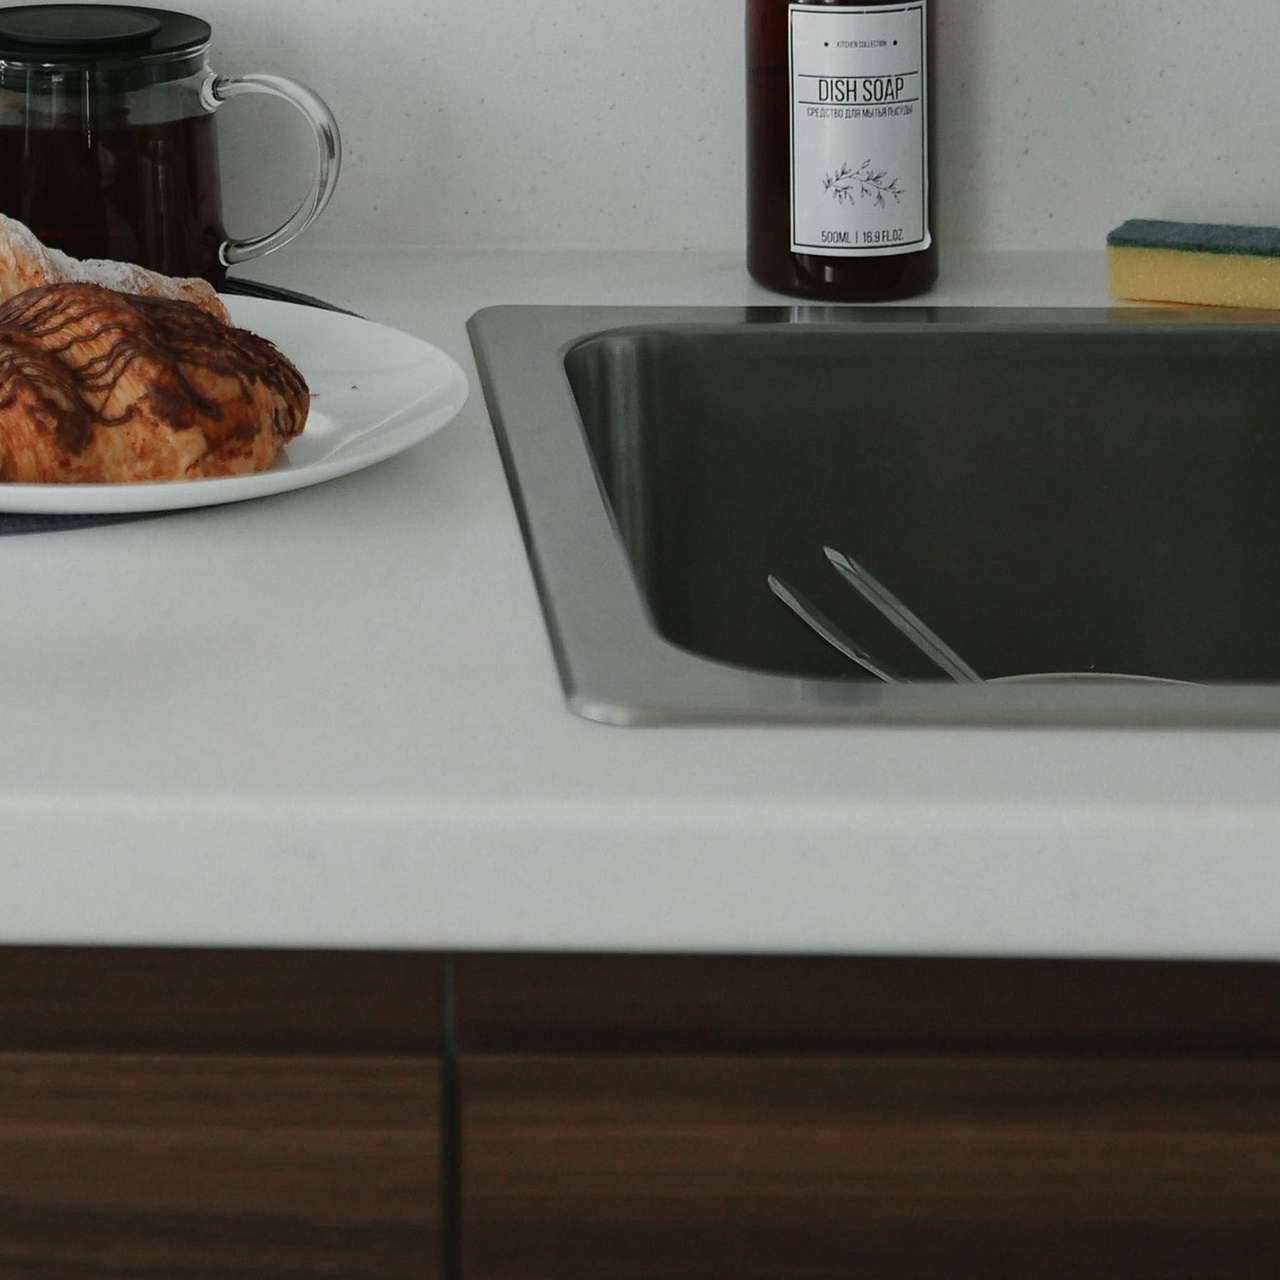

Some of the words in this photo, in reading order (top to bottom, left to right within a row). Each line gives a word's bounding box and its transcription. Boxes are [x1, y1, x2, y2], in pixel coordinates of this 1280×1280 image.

[819, 79, 857, 102] DISH
[863, 77, 904, 101] SOAP
[807, 107, 843, 118] СРЕДСТВО
[845, 107, 860, 119] ДЛЯ
[821, 231, 851, 243] 500ML
[863, 231, 880, 243] 16.9
